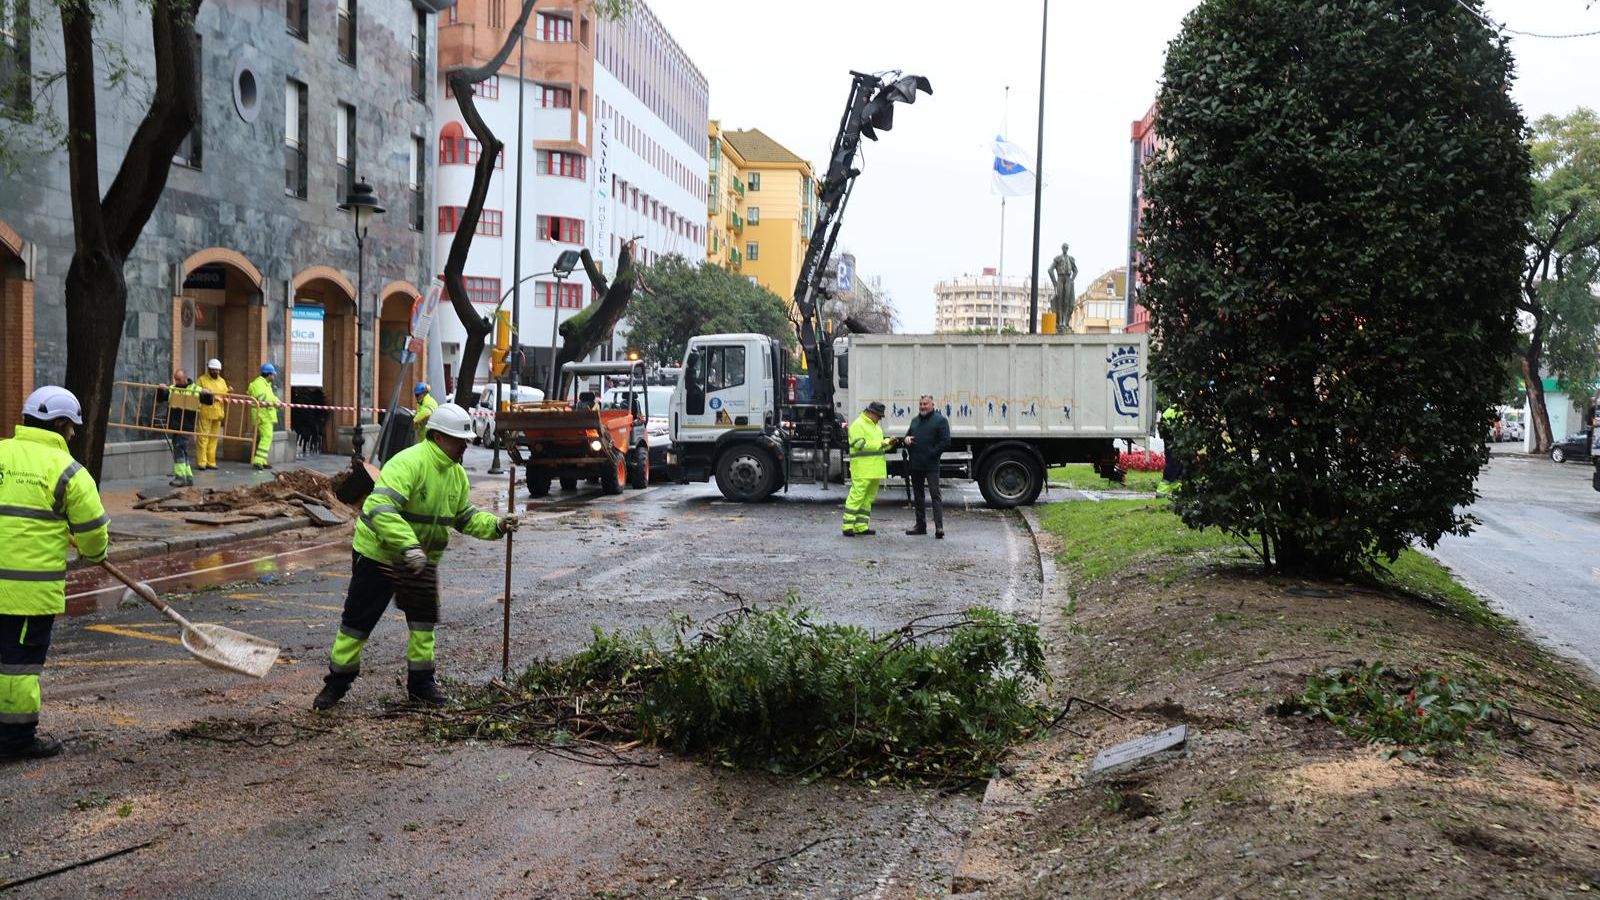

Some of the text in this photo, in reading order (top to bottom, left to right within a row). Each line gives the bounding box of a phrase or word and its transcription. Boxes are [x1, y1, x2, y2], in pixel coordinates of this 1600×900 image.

[598, 205, 606, 258] HOTELS
[188, 271, 220, 282] ORRO
[291, 328, 315, 339] dica
